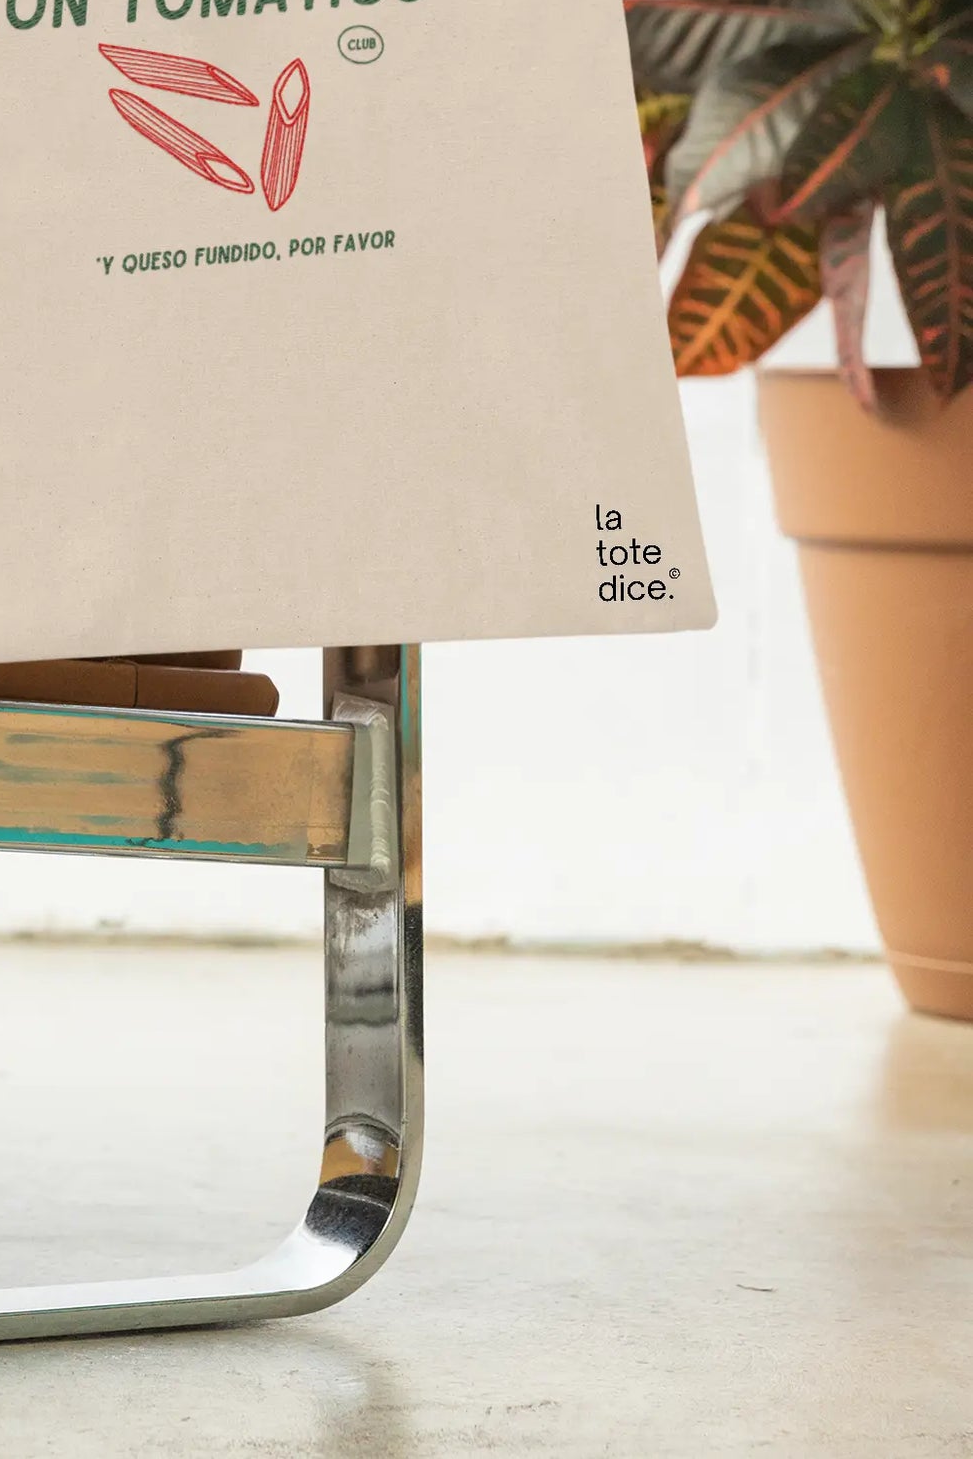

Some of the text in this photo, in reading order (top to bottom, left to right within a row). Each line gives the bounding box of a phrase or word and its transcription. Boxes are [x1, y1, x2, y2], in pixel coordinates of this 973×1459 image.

[347, 37, 377, 51] CLUB
[121, 249, 188, 275] QUESO
[194, 240, 281, 267] FUNDIDO,
[288, 236, 327, 258] POR
[332, 229, 396, 254] FAVOR
[595, 503, 623, 531] la
[595, 537, 662, 567] tote
